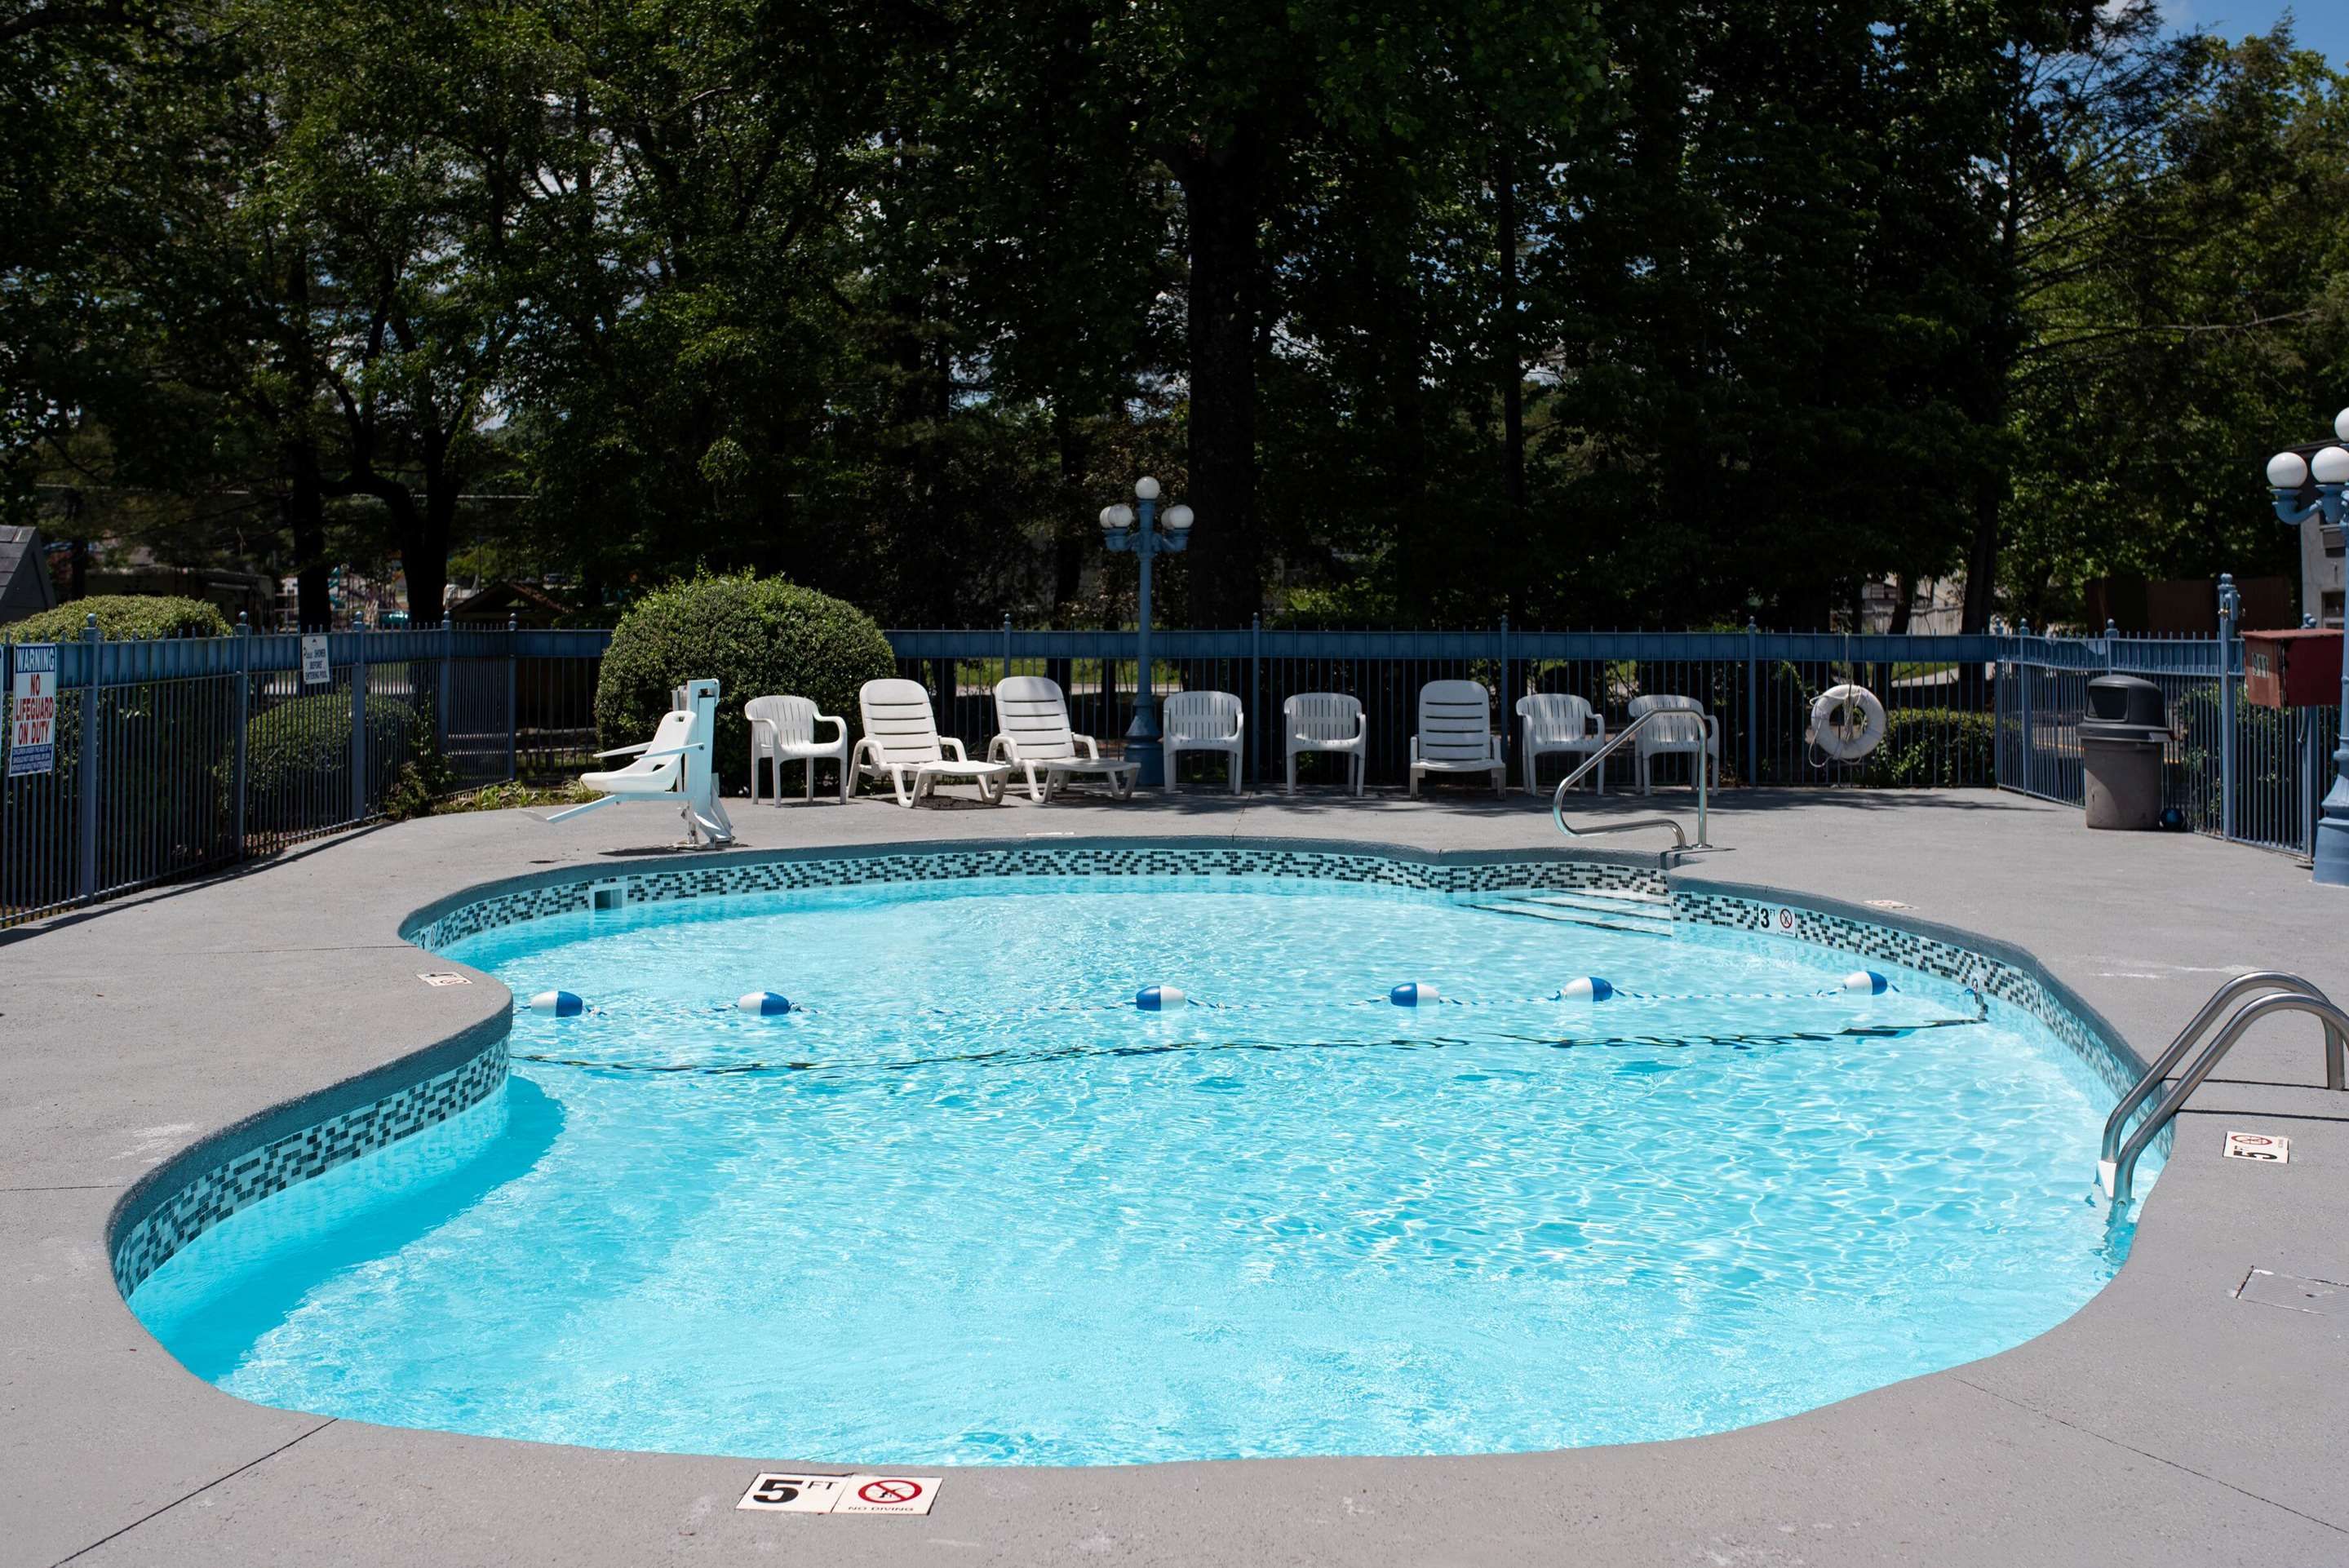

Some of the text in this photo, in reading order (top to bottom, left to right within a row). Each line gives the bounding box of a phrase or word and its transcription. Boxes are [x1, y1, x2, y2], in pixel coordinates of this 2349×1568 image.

[16, 648, 55, 671] WARNING
[30, 673, 40, 696] NO
[16, 697, 53, 721] LIFEGUARD
[19, 720, 50, 745] ON DUTY
[1761, 908, 1770, 928] 3
[753, 1479, 840, 1504] 5 FT
